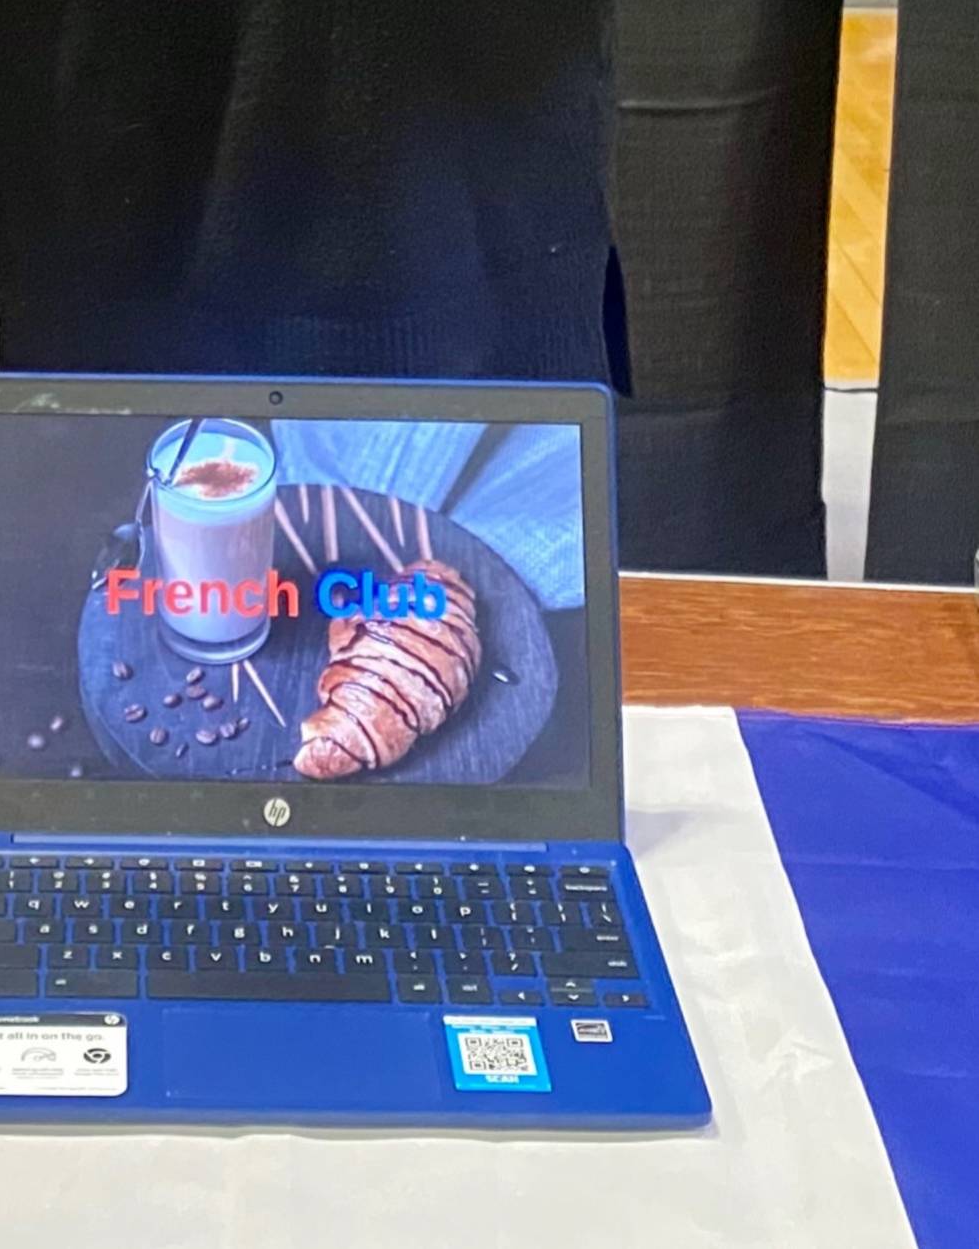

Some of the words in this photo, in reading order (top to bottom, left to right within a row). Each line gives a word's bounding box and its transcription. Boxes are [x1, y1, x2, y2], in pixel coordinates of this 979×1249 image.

[105, 569, 299, 617] French
[316, 568, 447, 620] Club
[266, 798, 288, 827] hp
[290, 883, 300, 893] 7
[28, 899, 40, 910] q
[73, 899, 90, 909] w
[124, 900, 135, 909] e
[173, 901, 182, 910] r
[221, 900, 229, 911] t
[267, 903, 279, 914] y
[315, 903, 328, 913] u
[411, 905, 424, 914] o
[459, 905, 472, 917] p
[39, 924, 51, 934] a
[88, 924, 98, 934] s
[136, 923, 148, 935] d
[186, 923, 195, 935] f
[234, 926, 246, 939] g
[281, 925, 294, 937] h
[333, 926, 341, 941] j
[379, 927, 390, 939] k
[63, 950, 73, 959] z
[112, 951, 123, 960] x
[161, 951, 172, 961] c
[210, 952, 222, 962] v
[259, 950, 272, 963] b
[309, 953, 322, 963] n
[355, 954, 374, 964] m
[6, 1031, 23, 1040] all
[26, 1031, 39, 1040] in
[61, 1032, 82, 1040] the
